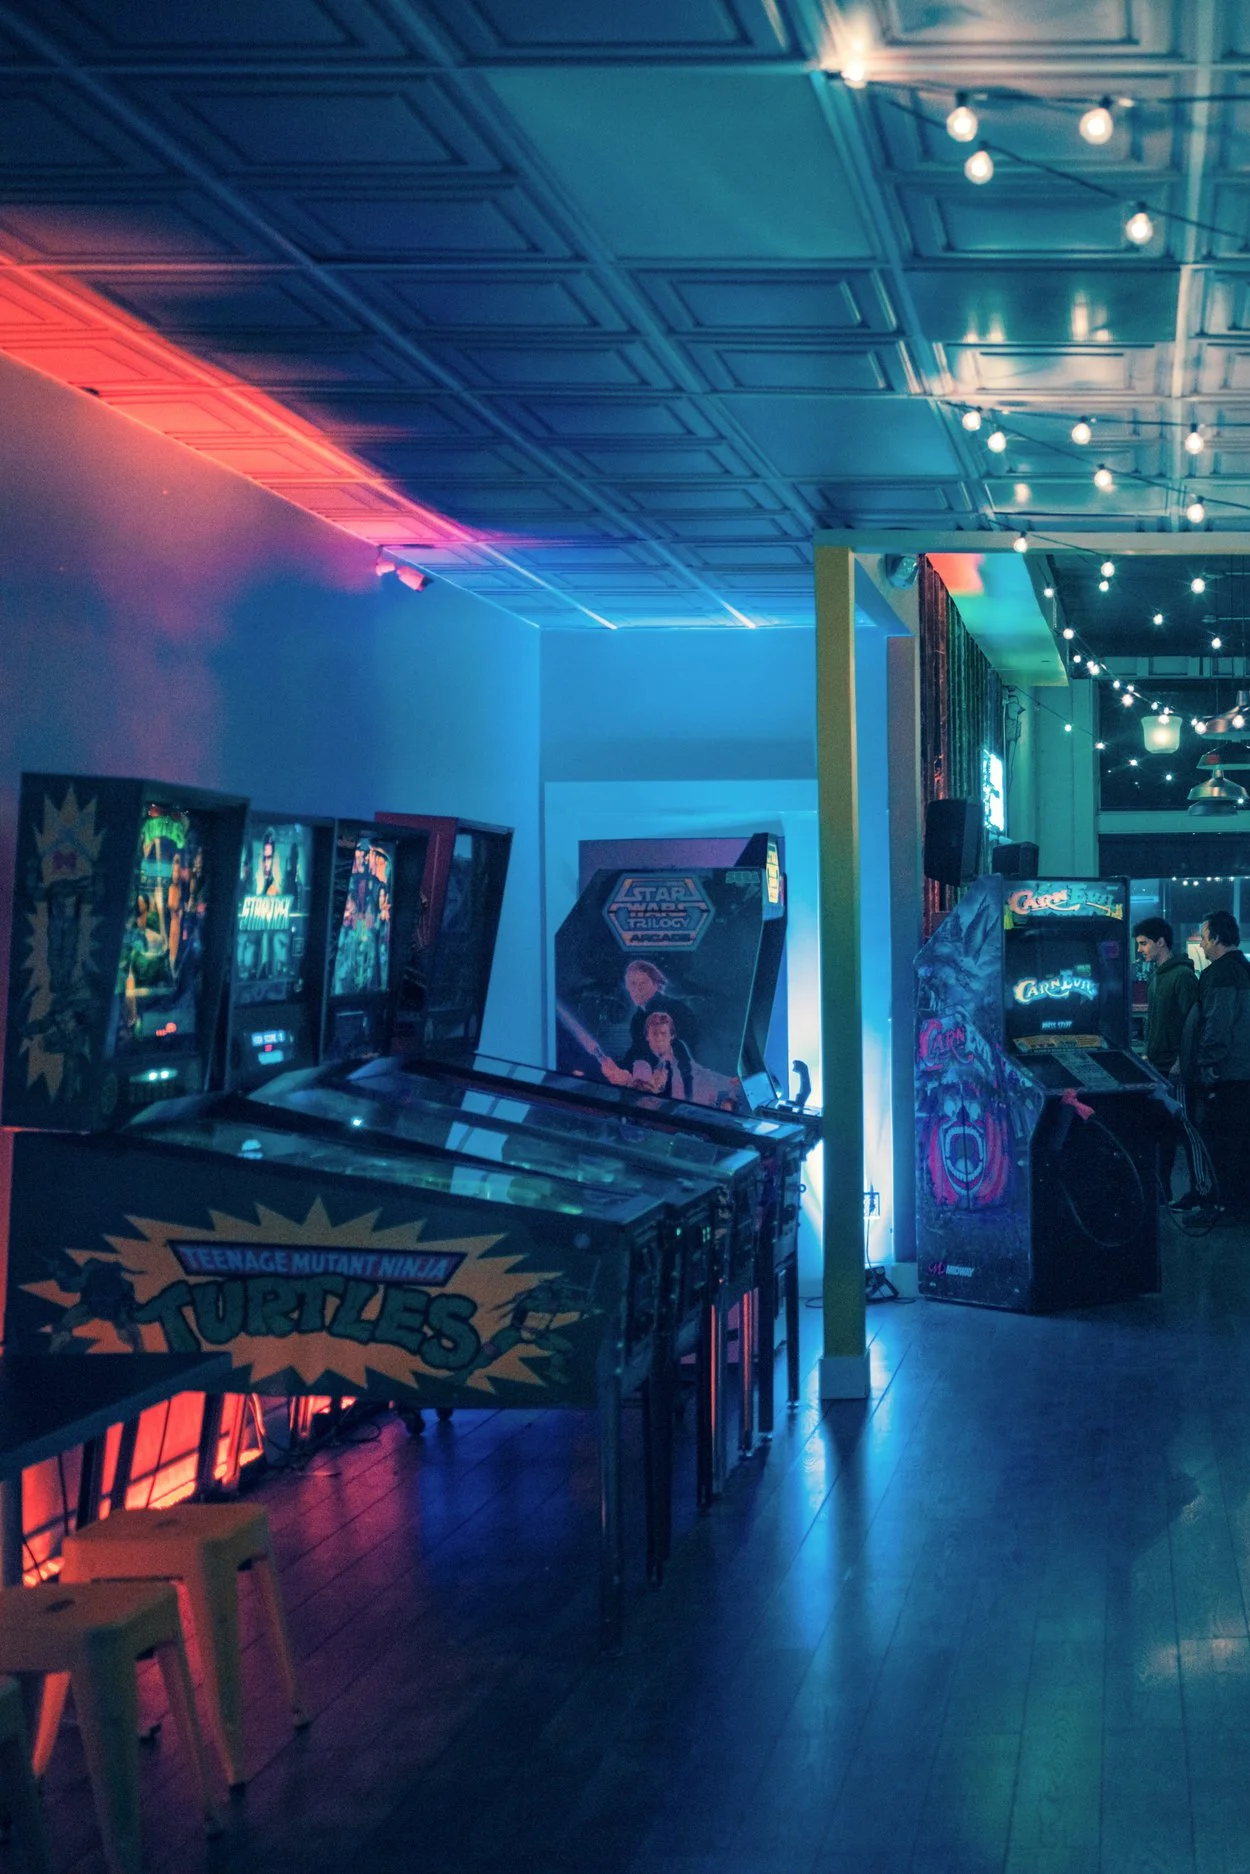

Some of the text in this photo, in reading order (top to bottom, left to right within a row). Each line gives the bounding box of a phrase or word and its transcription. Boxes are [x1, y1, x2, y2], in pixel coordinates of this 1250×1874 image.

[614, 886, 702, 902] STAR
[627, 918, 690, 929] TRILOGY
[184, 1248, 451, 1279] TEENAGE MUTANT NINJA
[134, 1275, 482, 1371] TURTLES
